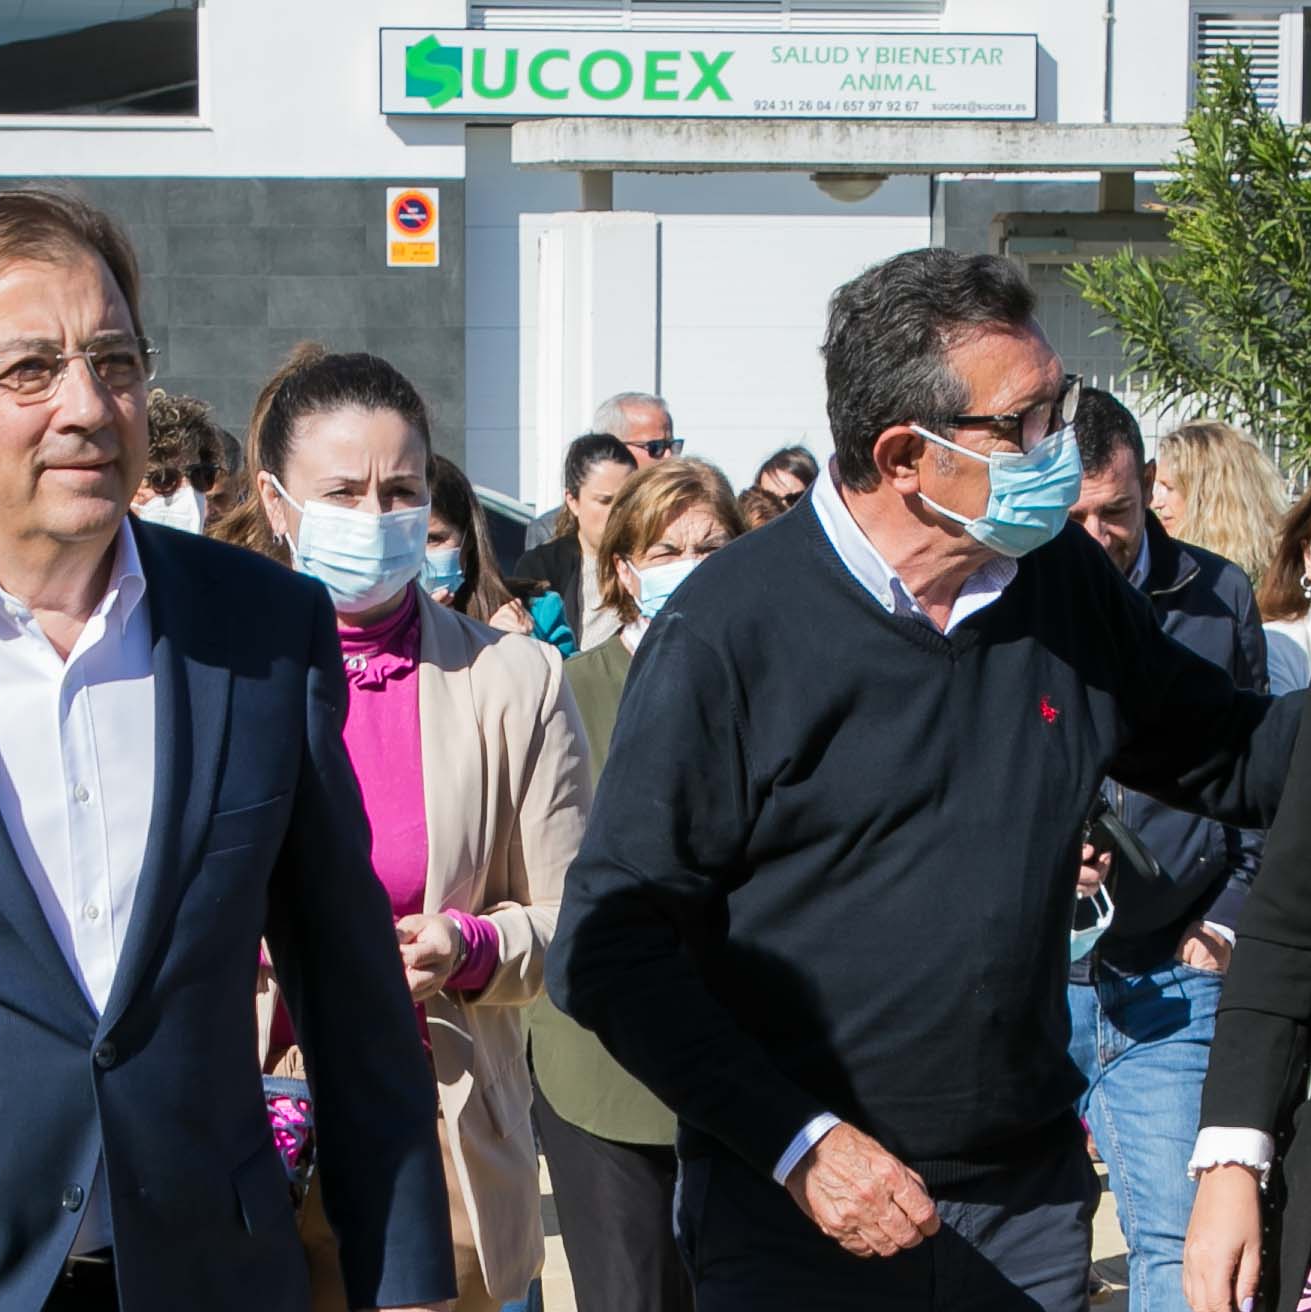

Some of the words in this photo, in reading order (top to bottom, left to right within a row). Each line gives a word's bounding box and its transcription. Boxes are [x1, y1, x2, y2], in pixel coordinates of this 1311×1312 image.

[771, 46, 849, 64] SALUD
[856, 47, 870, 64] Y
[875, 47, 1004, 66] BIENESTAR
[406, 34, 735, 109] SUCOEX
[840, 73, 937, 92] ANIMAL
[753, 99, 776, 111] 924
[779, 99, 794, 111] 31
[798, 100, 813, 111] 26
[816, 100, 831, 111] 04
[843, 100, 864, 112] 657
[868, 100, 883, 112] 97
[886, 101, 901, 112] 92
[905, 101, 919, 112] 67
[931, 102, 1028, 113] sucoex@sucoex.es
